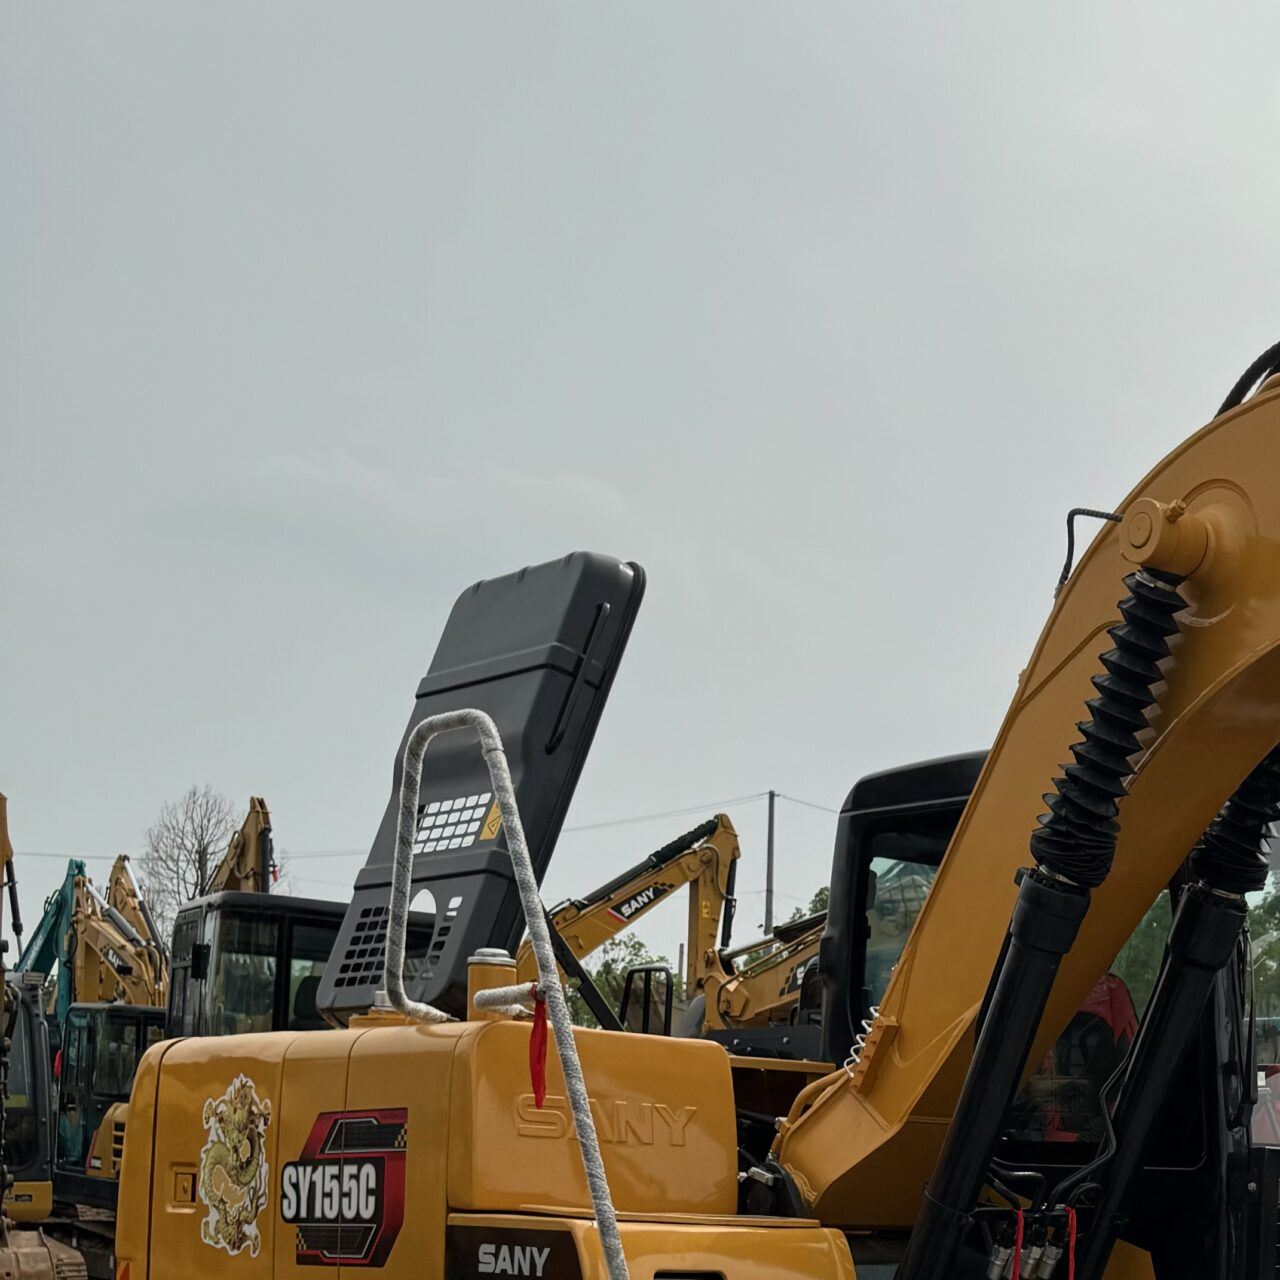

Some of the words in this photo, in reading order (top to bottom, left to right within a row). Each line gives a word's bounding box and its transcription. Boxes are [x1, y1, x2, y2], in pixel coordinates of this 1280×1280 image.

[621, 887, 655, 917] SANY
[282, 1163, 376, 1220] SY155C
[478, 1243, 550, 1277] SANY
